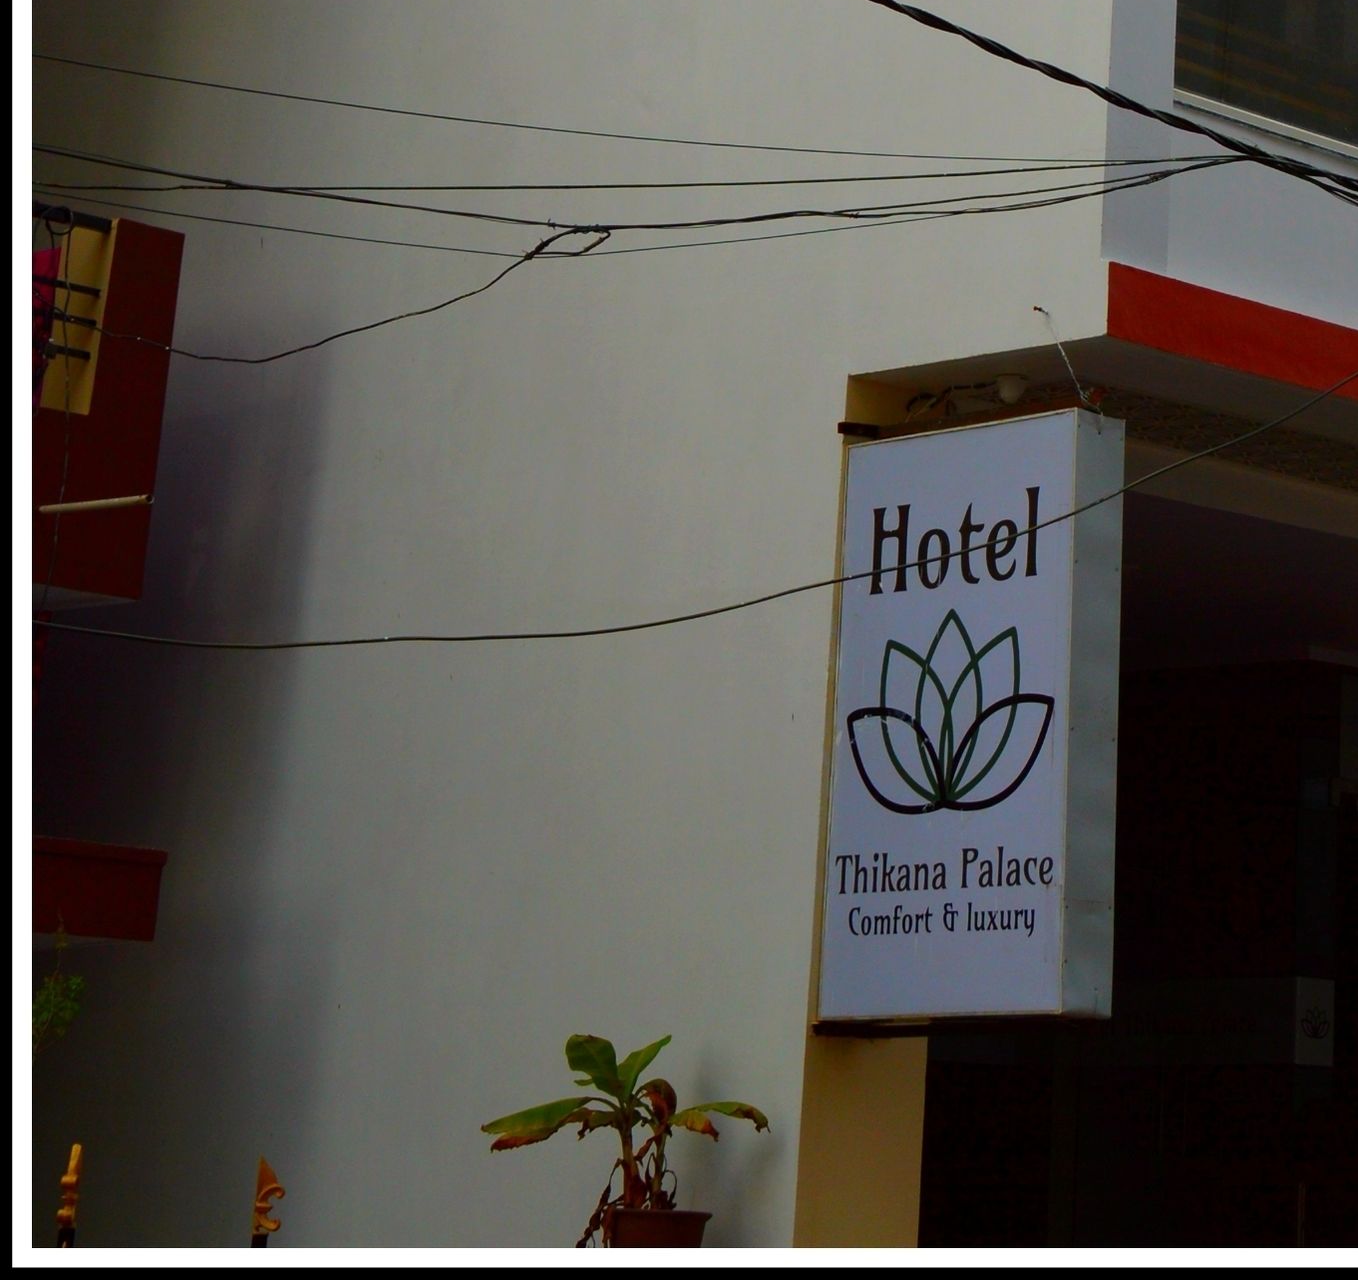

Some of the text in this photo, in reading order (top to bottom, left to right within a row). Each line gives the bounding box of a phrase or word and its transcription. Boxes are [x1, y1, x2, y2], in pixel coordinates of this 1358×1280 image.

[869, 486, 1040, 595] Hotel
[835, 846, 1055, 896] Thikana Palace
[847, 901, 1036, 938] Comfort & luxury
